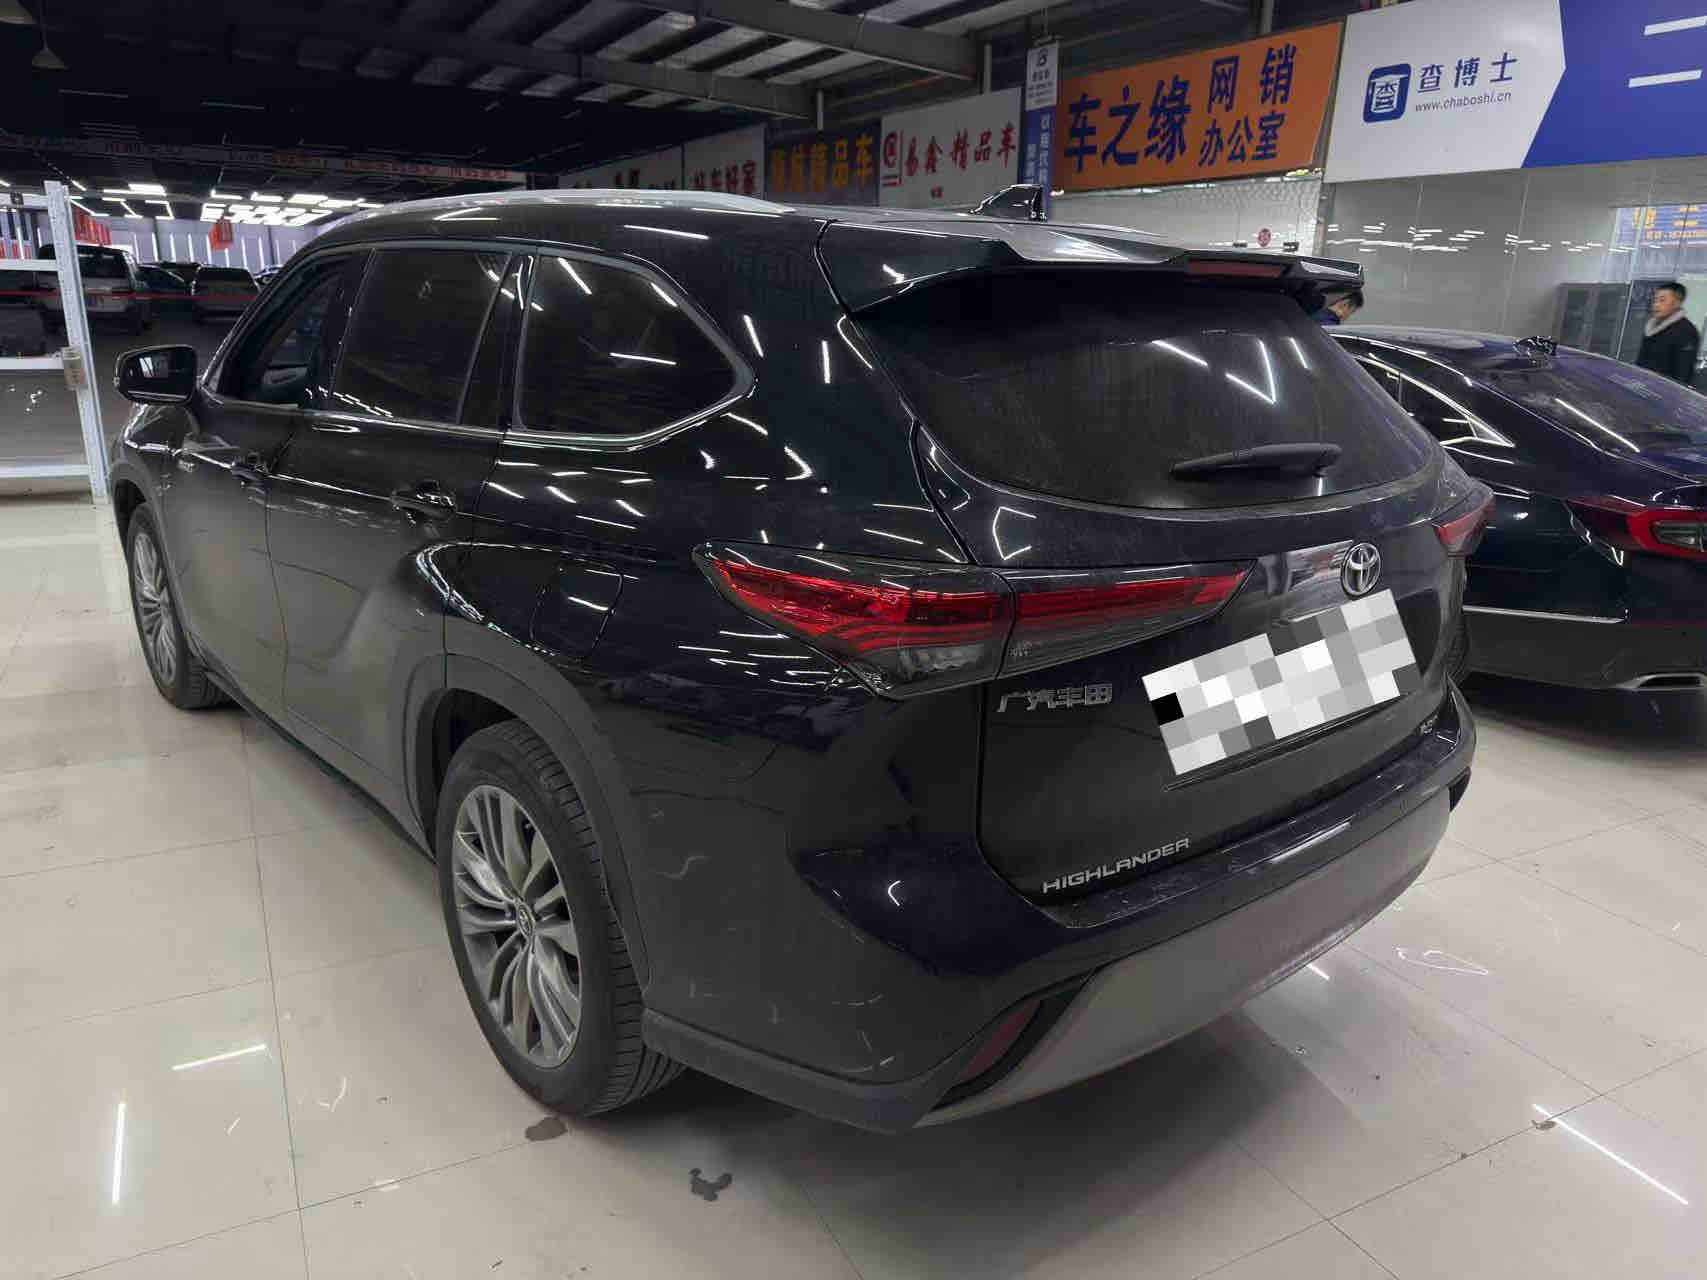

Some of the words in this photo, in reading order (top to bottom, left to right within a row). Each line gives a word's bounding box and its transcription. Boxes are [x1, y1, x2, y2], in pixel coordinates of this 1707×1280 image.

[1417, 52, 1518, 93] 查博士
[1064, 74, 1192, 174] 车之缘
[1415, 91, 1512, 112] www.chaboshi.cn
[1198, 109, 1284, 167] 办公室
[996, 682, 1113, 713] 广汽丰田
[1042, 837, 1190, 894] HIGHLANDER
